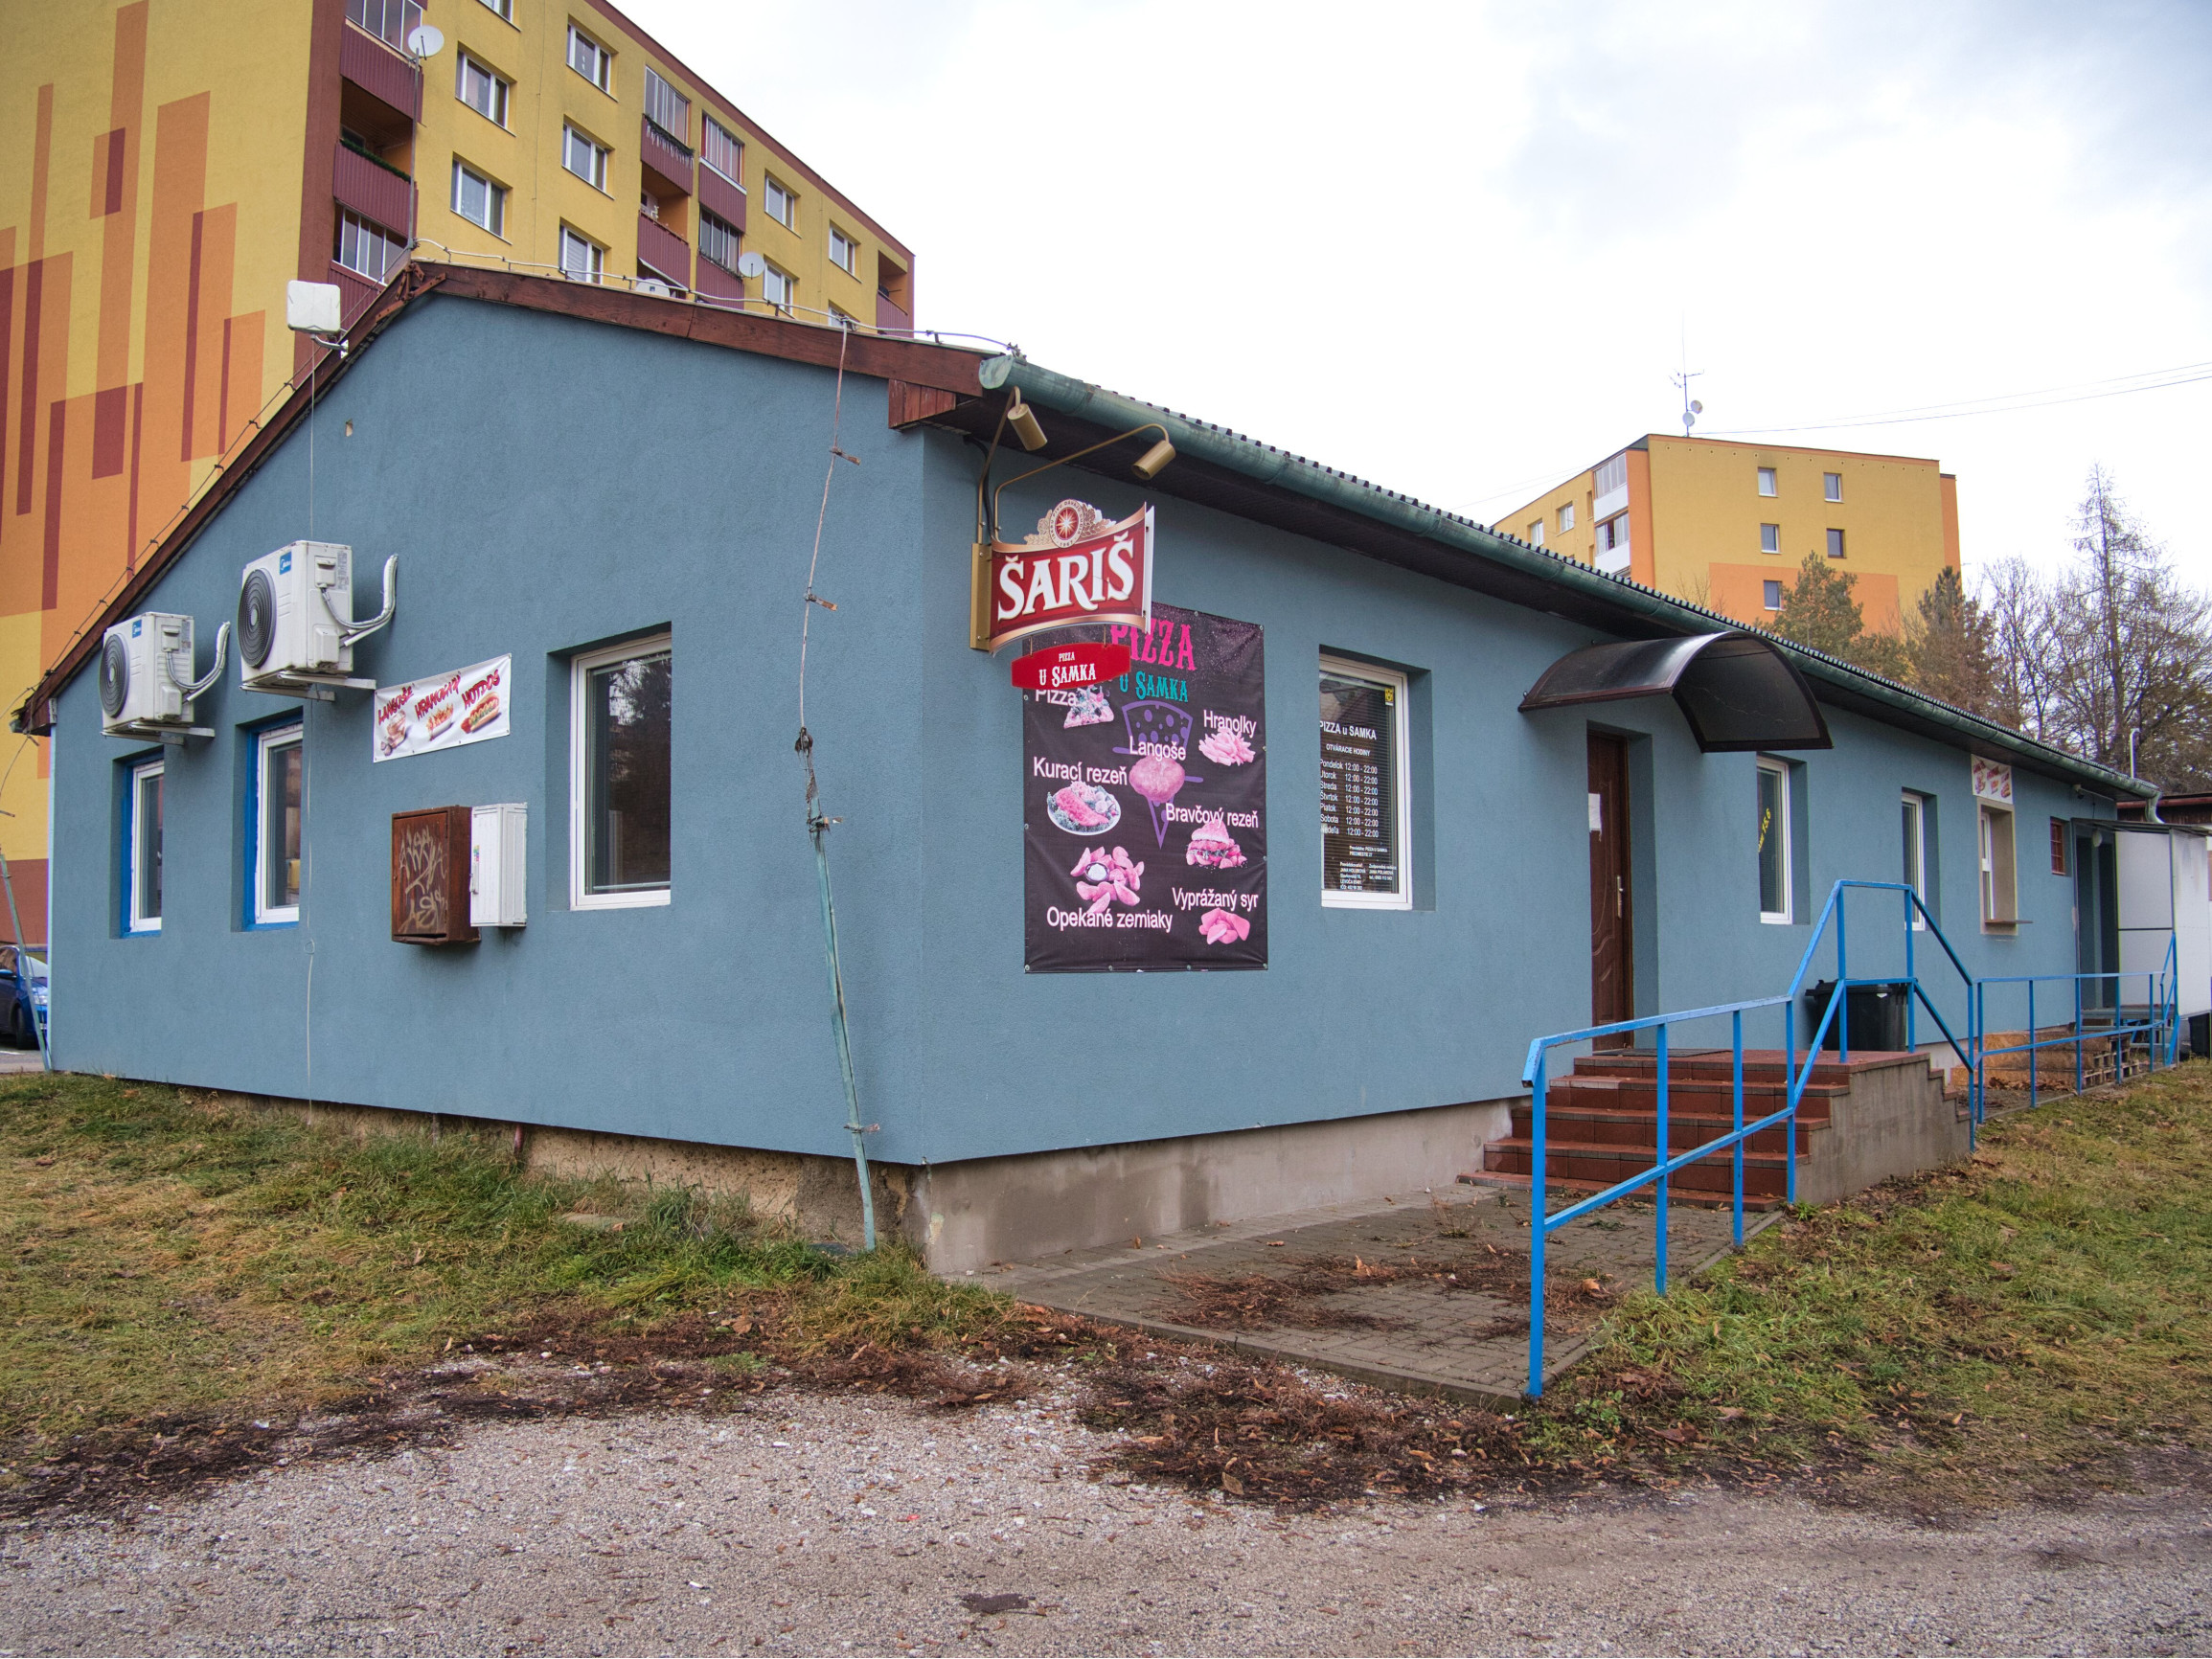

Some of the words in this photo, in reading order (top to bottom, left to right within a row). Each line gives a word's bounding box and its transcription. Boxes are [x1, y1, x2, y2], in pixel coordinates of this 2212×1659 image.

[997, 531, 1134, 621] ŠARIŠ
[1059, 651, 1075, 662] PIZZA
[1038, 669, 1046, 686] U
[1052, 663, 1096, 688] SAMKA
[1135, 670, 1188, 703] SAMKA
[1036, 689, 1077, 707] Pizza
[1203, 710, 1257, 738] Hranolky
[1349, 726, 1377, 740] SAMKA
[1129, 736, 1186, 762] Langoše
[1326, 743, 1353, 754] OTVÁRACIE
[1353, 747, 1371, 757] HODINY
[1034, 757, 1082, 780] Kurací
[1086, 765, 1128, 785] rezeň
[1345, 762, 1359, 772] 12:00
[1363, 765, 1378, 774] 22:00
[1345, 773, 1359, 783] 12:00
[1363, 776, 1378, 784] 22:00
[1345, 784, 1359, 793] 12:00
[1364, 786, 1378, 795] 22:00
[1345, 795, 1359, 804] 12:00
[1364, 797, 1378, 806] 22:00
[1166, 803, 1224, 830] Bravčový
[1227, 808, 1259, 828] rezeň
[1345, 806, 1359, 814] 12:00
[1346, 816, 1360, 825] 12:00
[1364, 818, 1379, 827] 22:00
[1347, 828, 1360, 836] 12:00
[1365, 829, 1379, 837] 22:00
[1172, 887, 1238, 912] Vyprážaný
[1241, 894, 1259, 910] syr
[1046, 906, 1113, 931] Opekané
[1116, 910, 1173, 933] zemiaky
